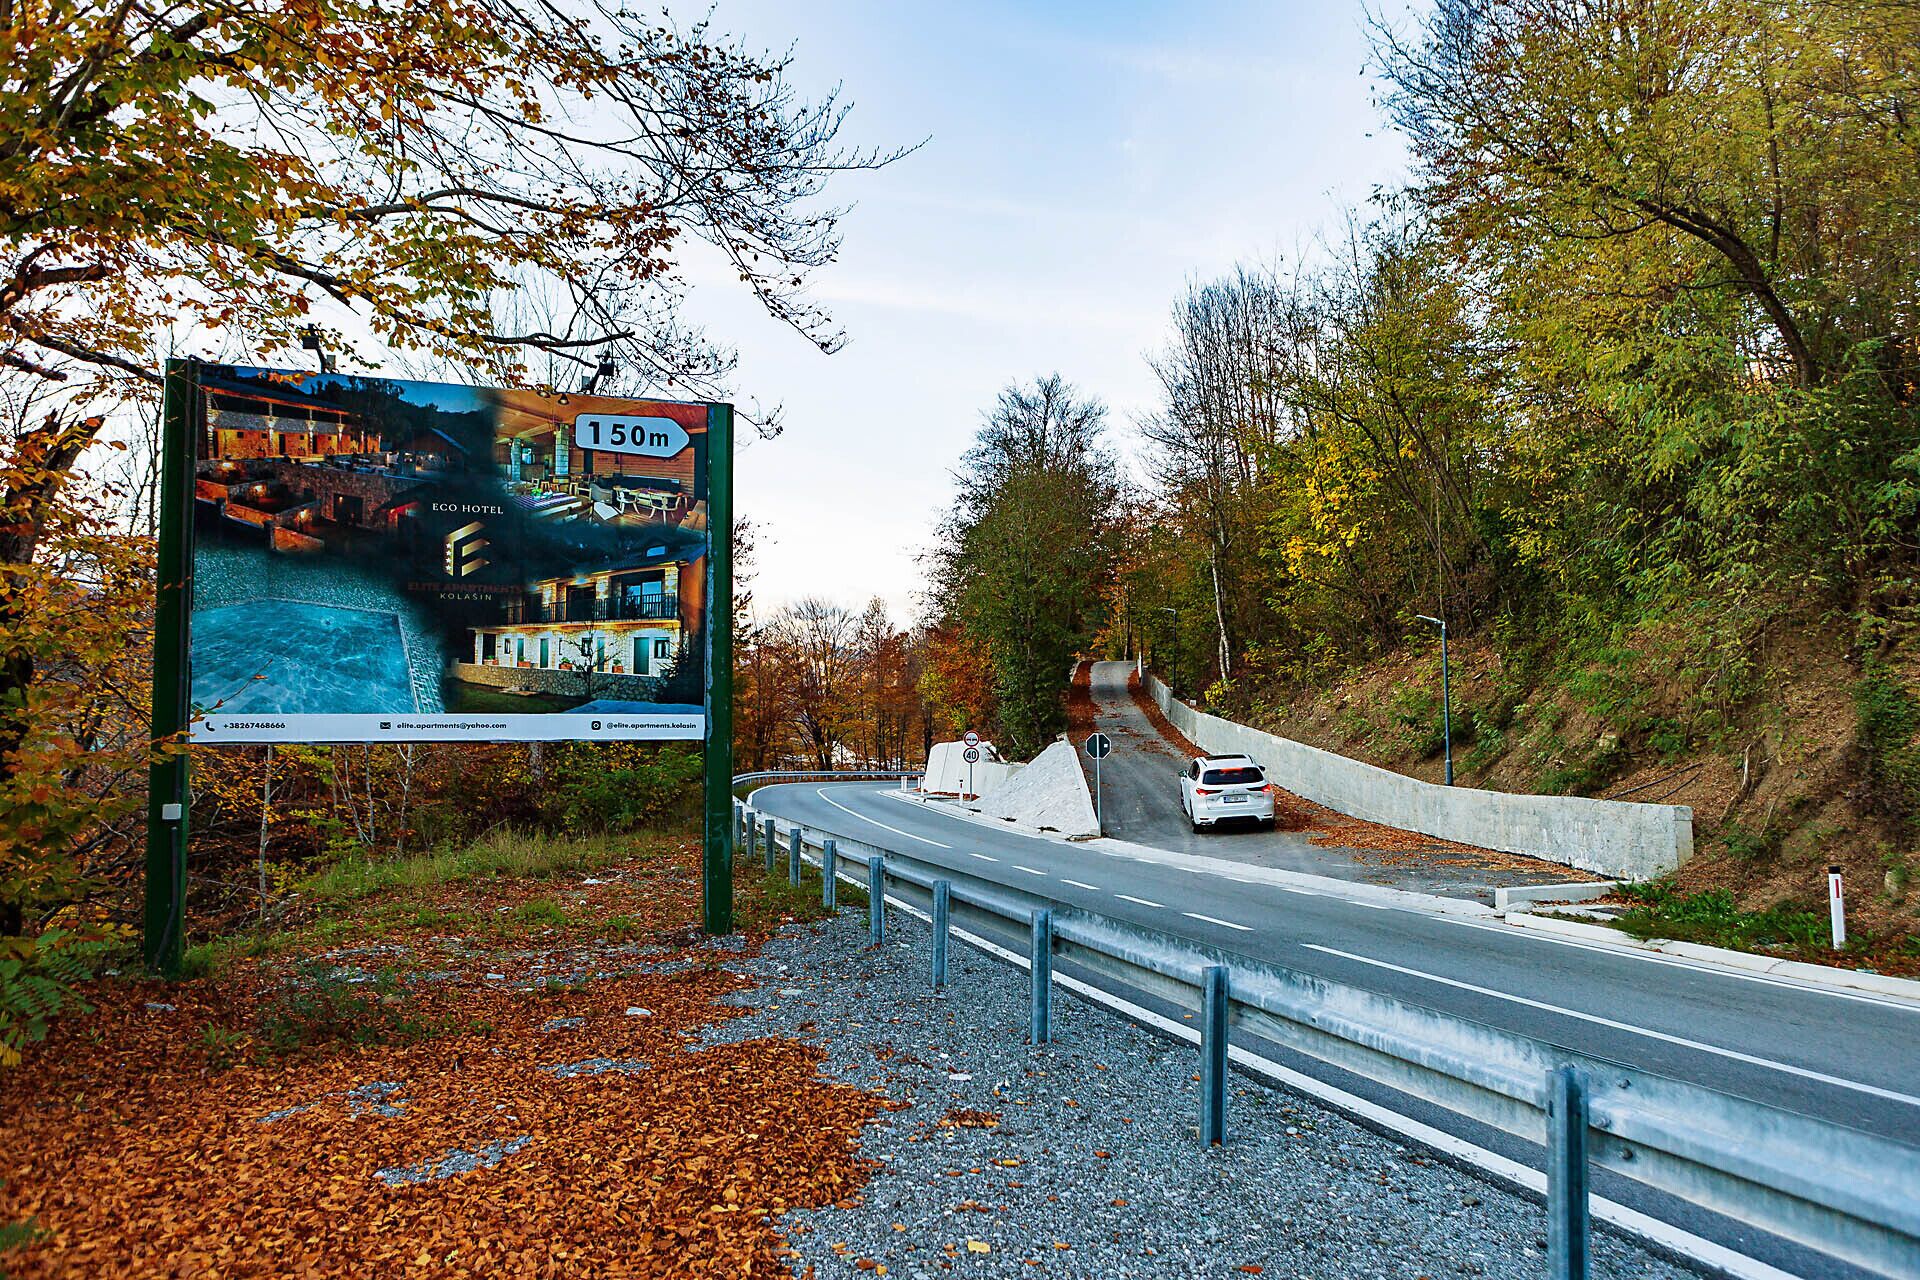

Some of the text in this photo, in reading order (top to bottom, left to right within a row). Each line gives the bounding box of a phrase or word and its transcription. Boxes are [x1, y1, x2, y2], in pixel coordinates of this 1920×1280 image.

[587, 420, 669, 447] 150m
[432, 502, 504, 515] ECO HOTEL
[396, 722, 507, 730] elite.apartments@yahoo.com
[606, 722, 697, 730] @elite.apartments.kolasin
[966, 750, 977, 760] 40
